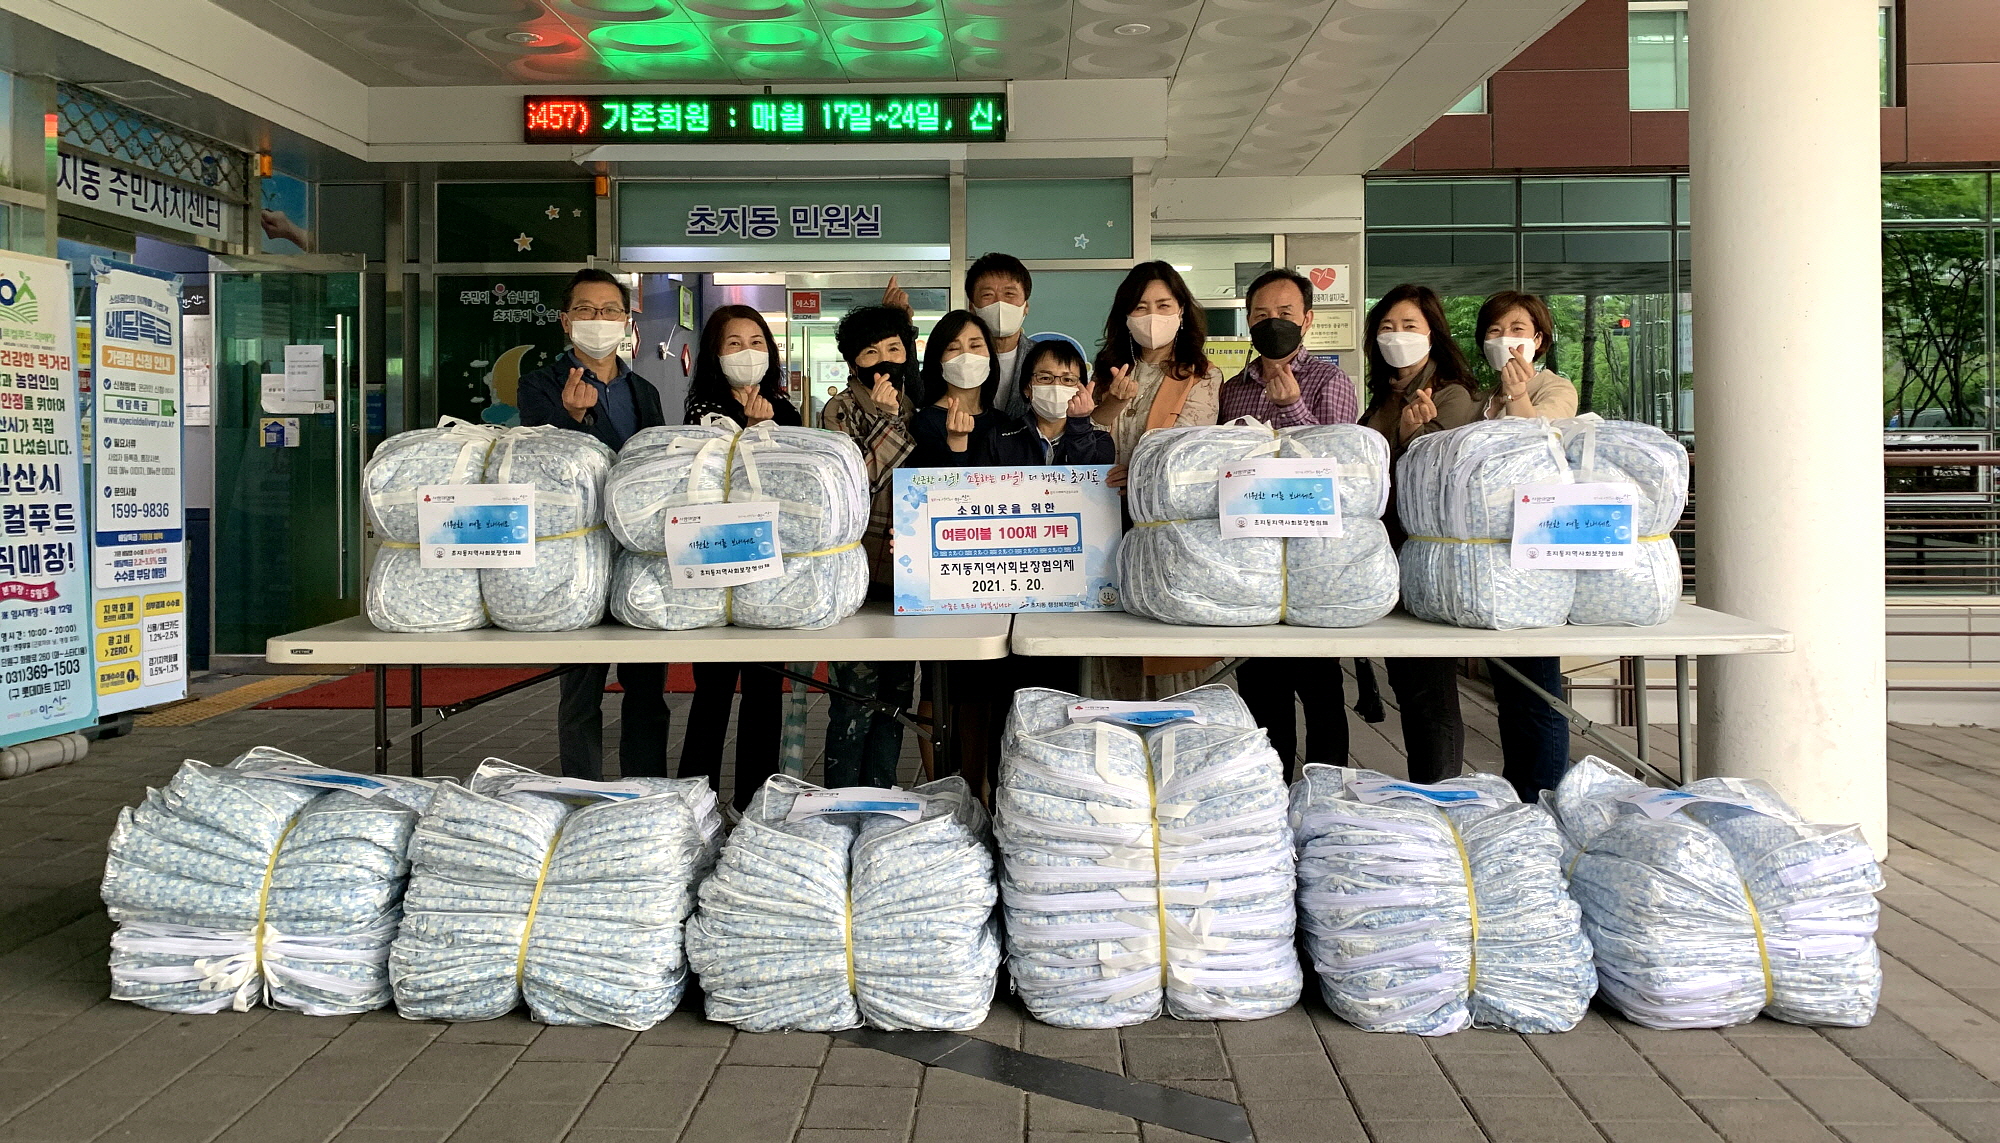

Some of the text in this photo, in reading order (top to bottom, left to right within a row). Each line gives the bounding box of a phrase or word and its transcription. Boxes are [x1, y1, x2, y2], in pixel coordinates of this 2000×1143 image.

[602, 102, 709, 132] 기존회원
[752, 102, 804, 132] 매월
[822, 101, 953, 131] 17일~24일,
[969, 101, 1001, 131] 신
[57, 151, 221, 233] 지동 주민자치센터
[687, 204, 881, 239] 초지동 민원실
[460, 290, 490, 305] 주민이
[493, 308, 532, 323] 초지동이
[105, 310, 172, 346] 배달특급
[0, 350, 71, 372] 건강한 먹거리
[153, 355, 171, 372] 안내
[0, 372, 59, 391] 과 농업인의
[1, 392, 65, 412] 안정을 위하여
[32, 417, 54, 434] 직접
[103, 416, 175, 429] www.specialdelivery.co.kr
[13, 438, 72, 456] 나섰습니다.
[966, 472, 996, 486] 소통하는
[1001, 471, 1023, 486] 마을!
[1070, 469, 1100, 486] 초지동
[111, 502, 170, 519] 1599-9836
[1031, 502, 1055, 513] 위한
[3, 503, 76, 535] 컬푸드
[941, 524, 1069, 542] 여름이불 100채 기탁
[0, 541, 75, 577] 직매장!
[940, 559, 1075, 576] 초지동지역사회보장협의체
[113, 569, 136, 582] 수수료
[136, 568, 151, 580] 부담
[972, 578, 1045, 593] 2021. 5. 20.
[28, 628, 47, 638] 10:00
[55, 624, 77, 635] 20:00)
[5, 659, 80, 685] 031)369-1503
